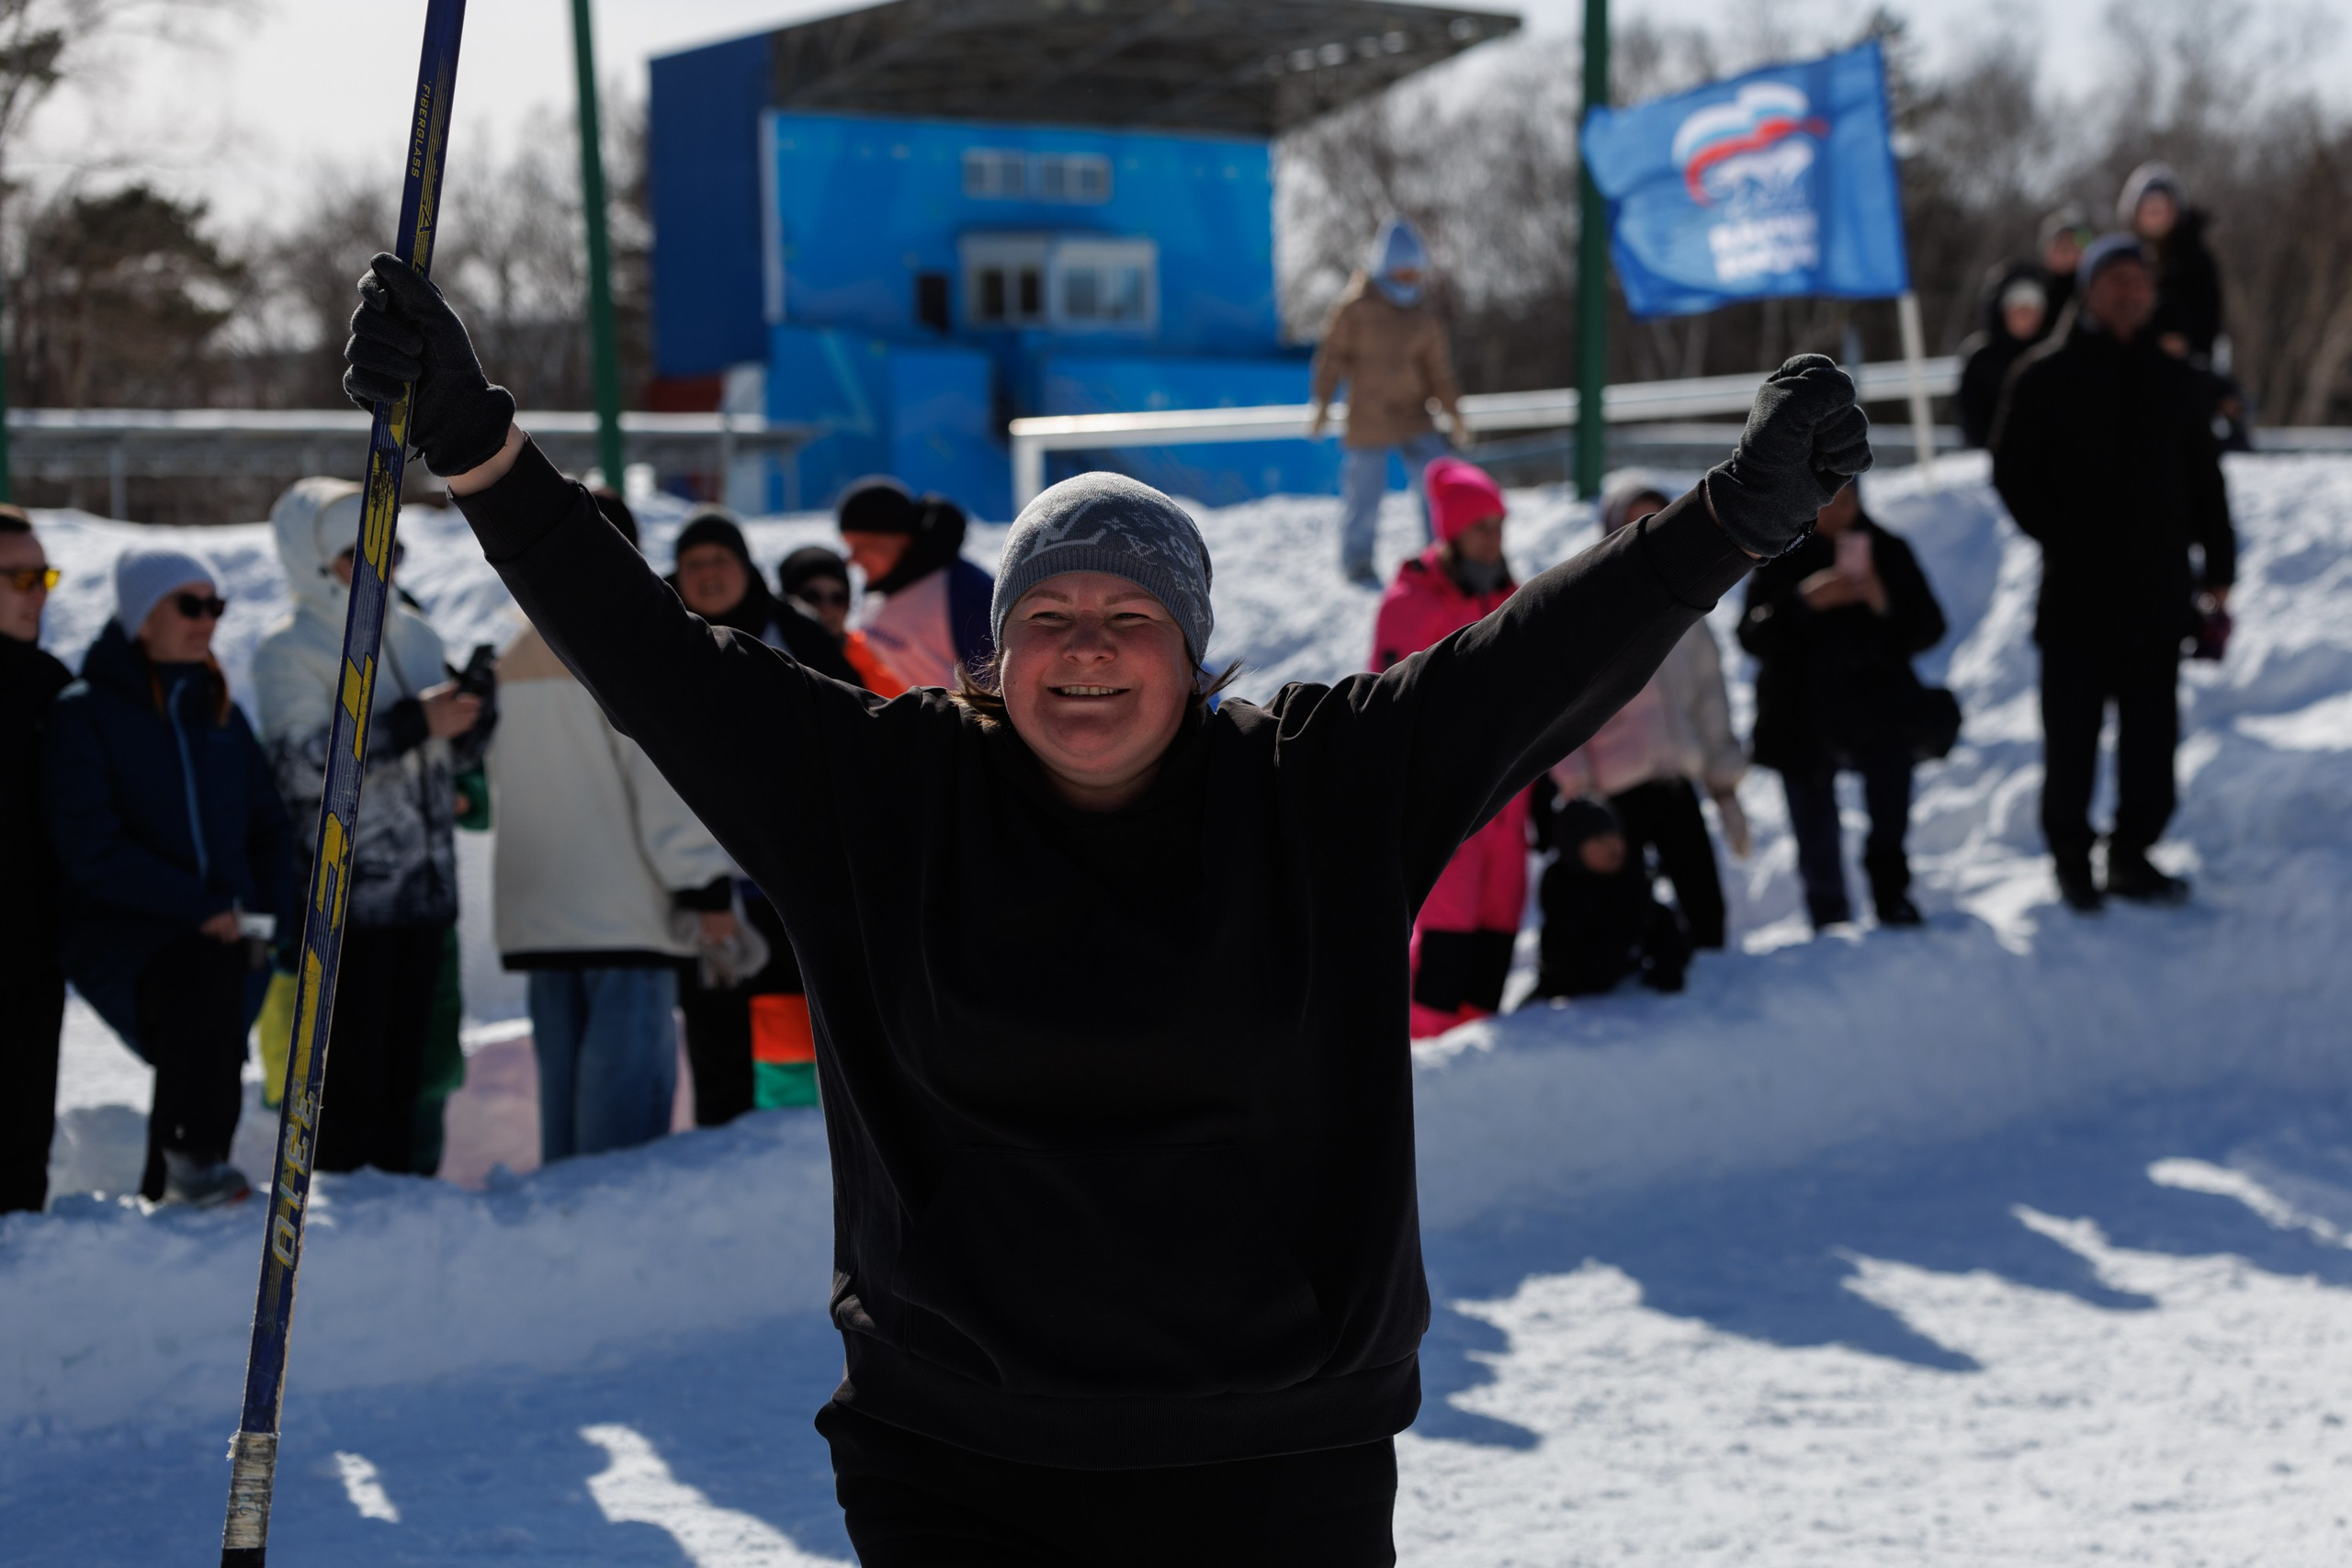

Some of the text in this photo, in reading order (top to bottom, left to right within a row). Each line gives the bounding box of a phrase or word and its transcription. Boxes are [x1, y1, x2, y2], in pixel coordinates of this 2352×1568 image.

[411, 84, 431, 178] FIBERGLASS
[1785, 533, 1805, 553] DEMIX
[272, 1078, 318, 1270] 3310
